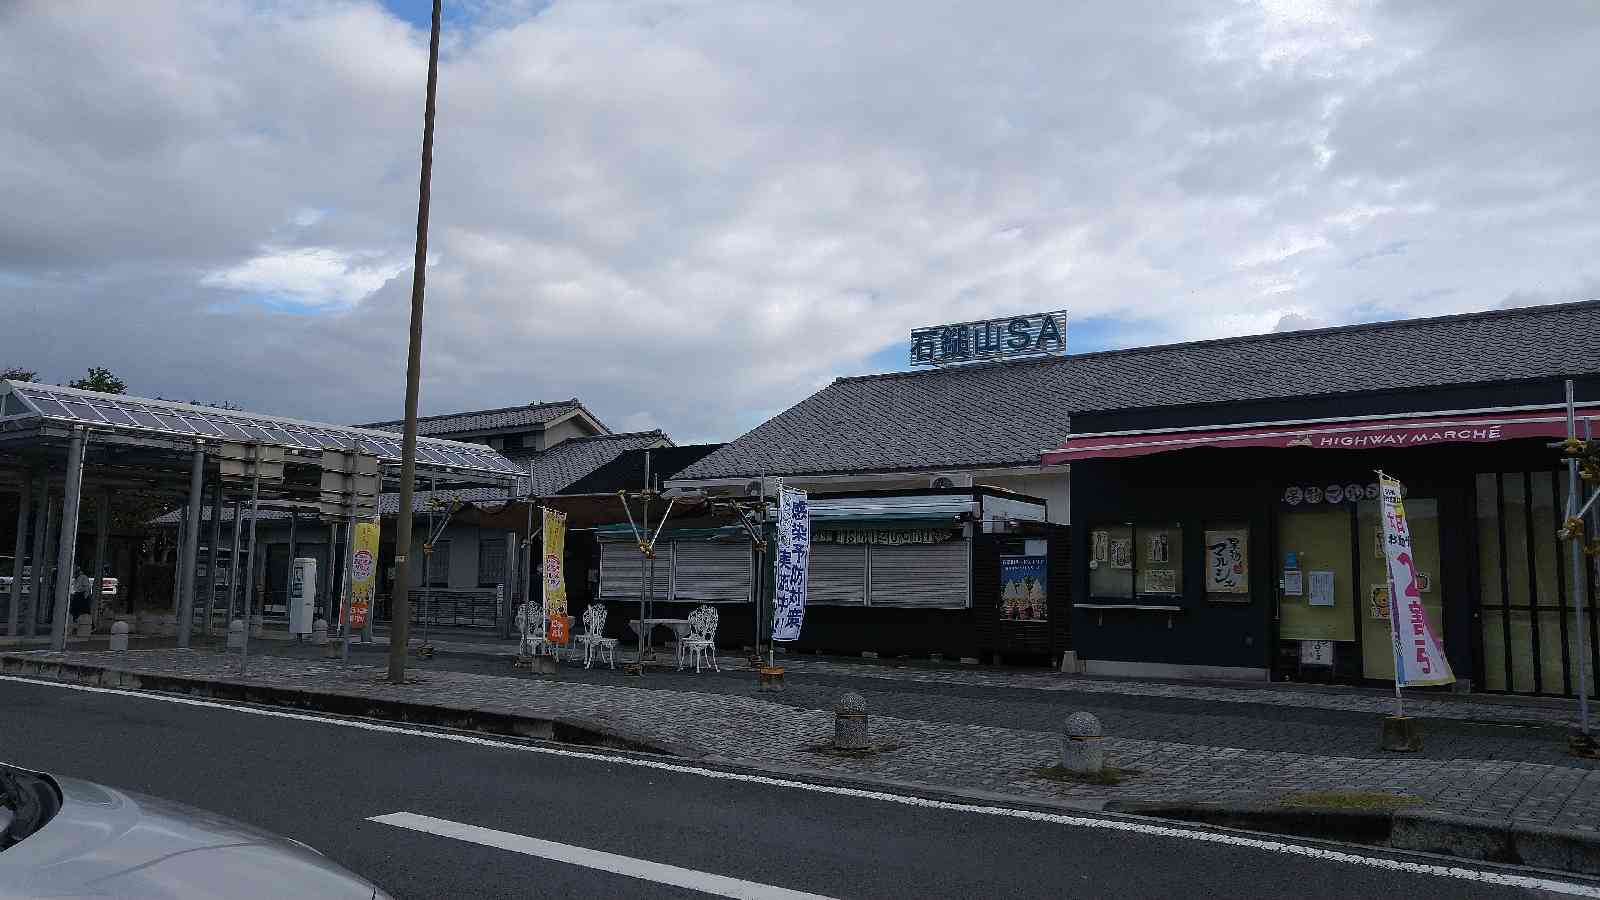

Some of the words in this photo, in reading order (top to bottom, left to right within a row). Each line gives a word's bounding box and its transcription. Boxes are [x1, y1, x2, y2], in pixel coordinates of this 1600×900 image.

[1320, 433, 1409, 447] HIGHWAY
[786, 500, 806, 627] 感染予防対策
